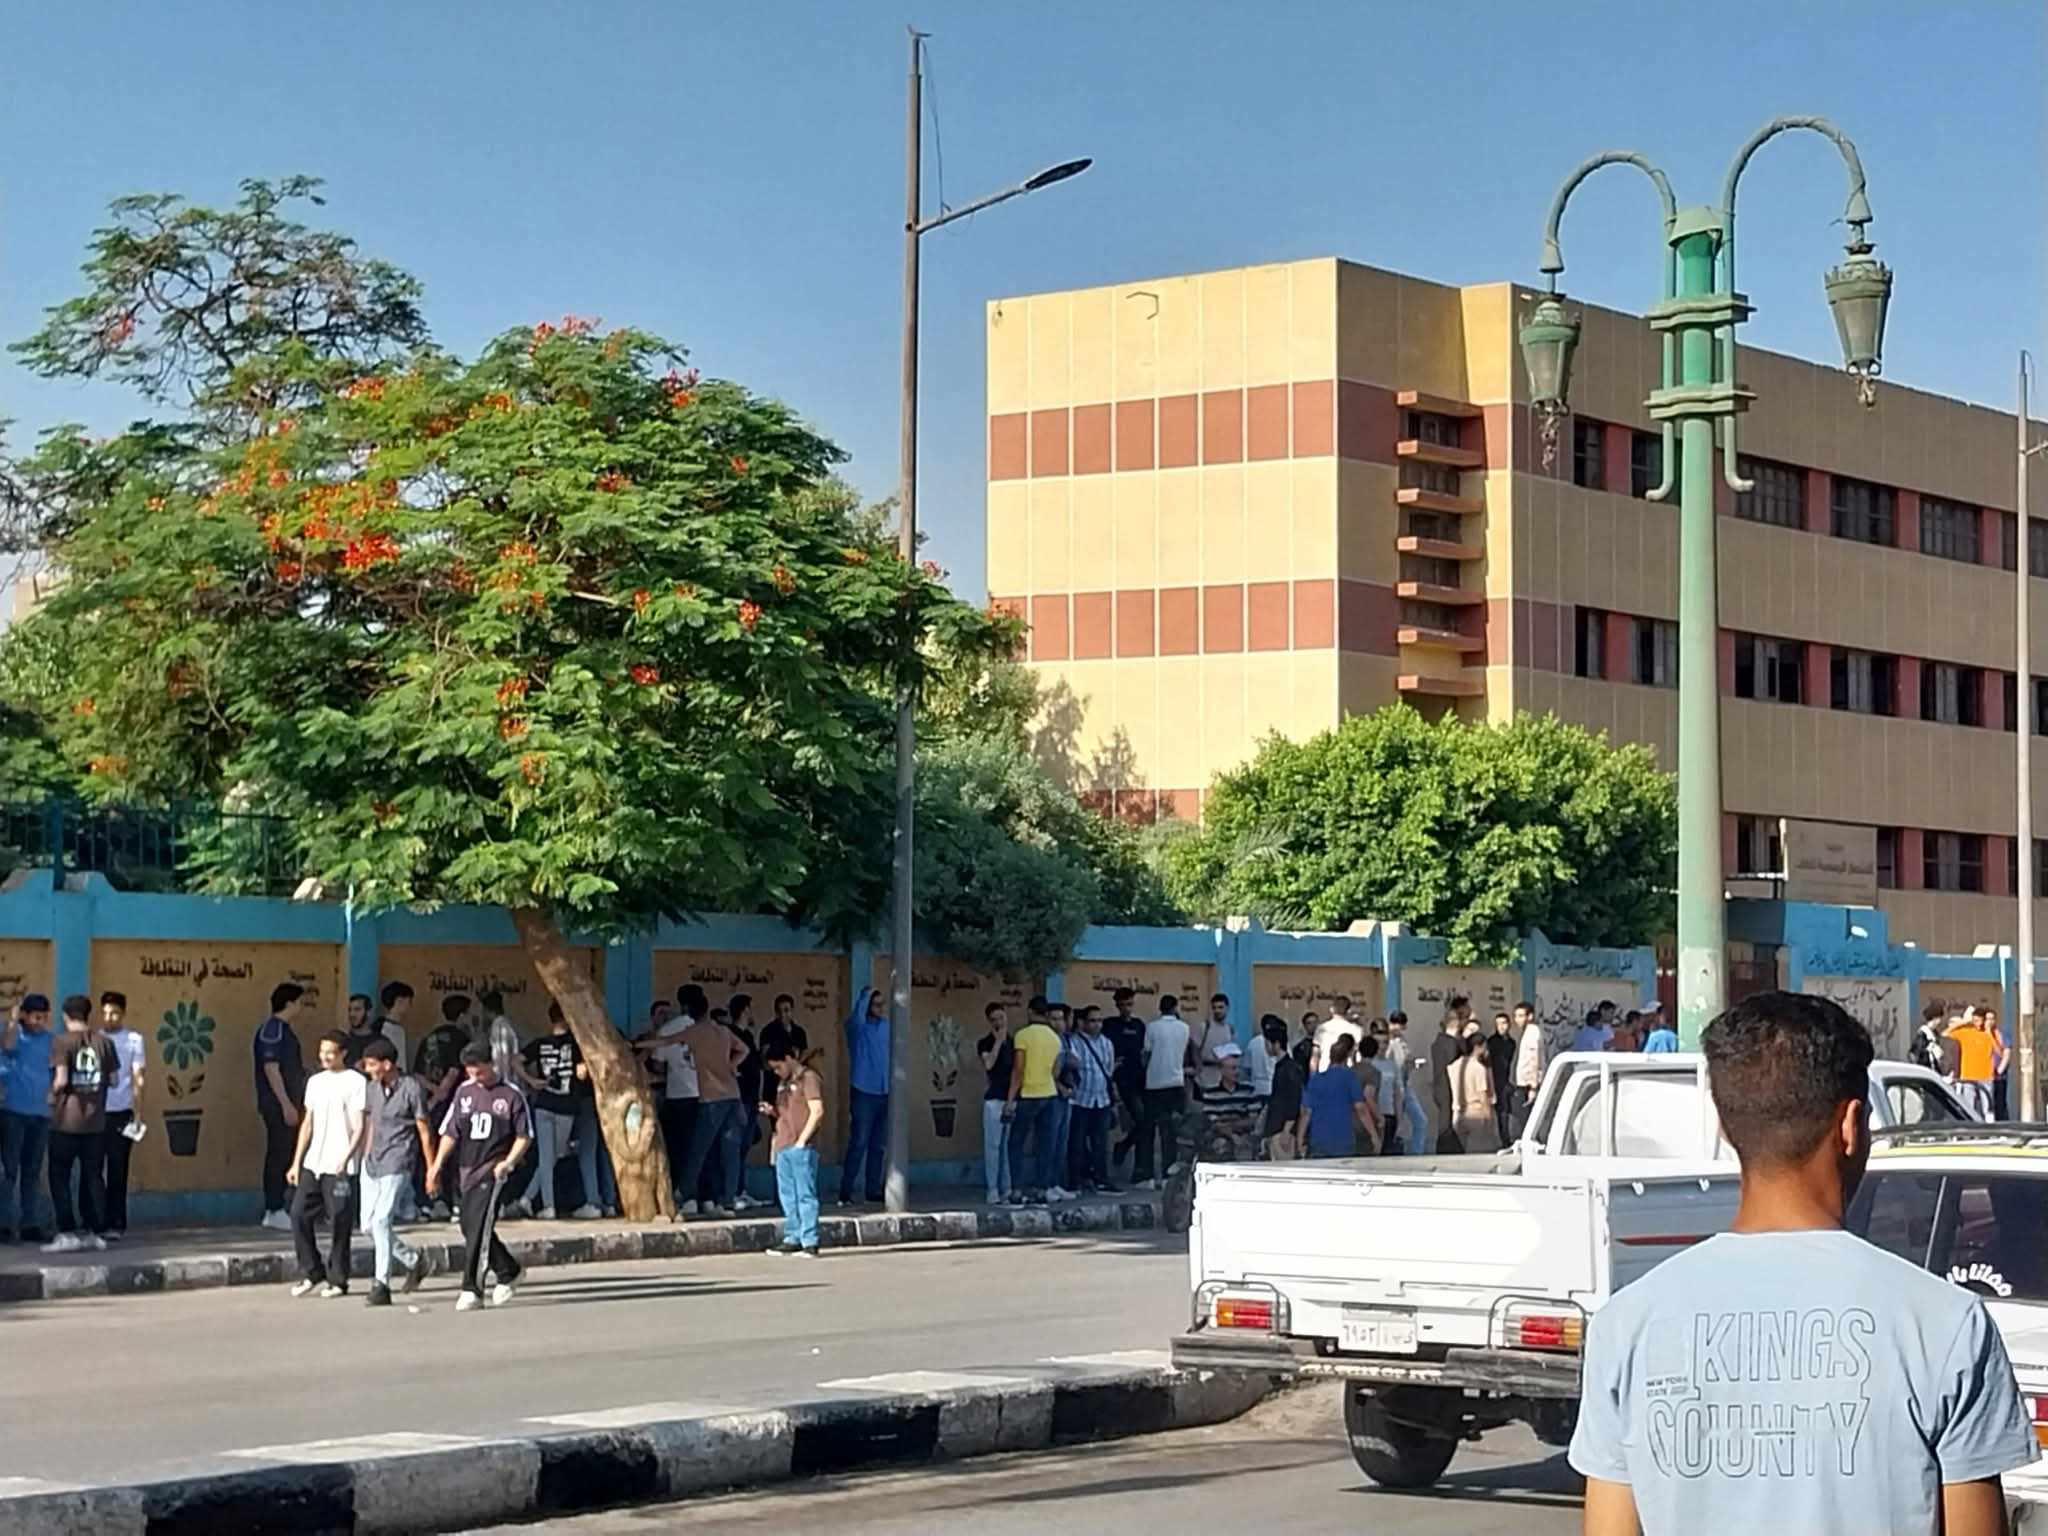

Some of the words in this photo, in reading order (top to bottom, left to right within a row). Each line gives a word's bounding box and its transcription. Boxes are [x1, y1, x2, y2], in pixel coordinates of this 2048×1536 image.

[193, 957, 208, 987] في
[210, 957, 253, 978] الصحة
[470, 1112, 493, 1140] 10
[1693, 1308, 1876, 1383] KINGS
[1648, 1399, 1871, 1478] COUNTY
